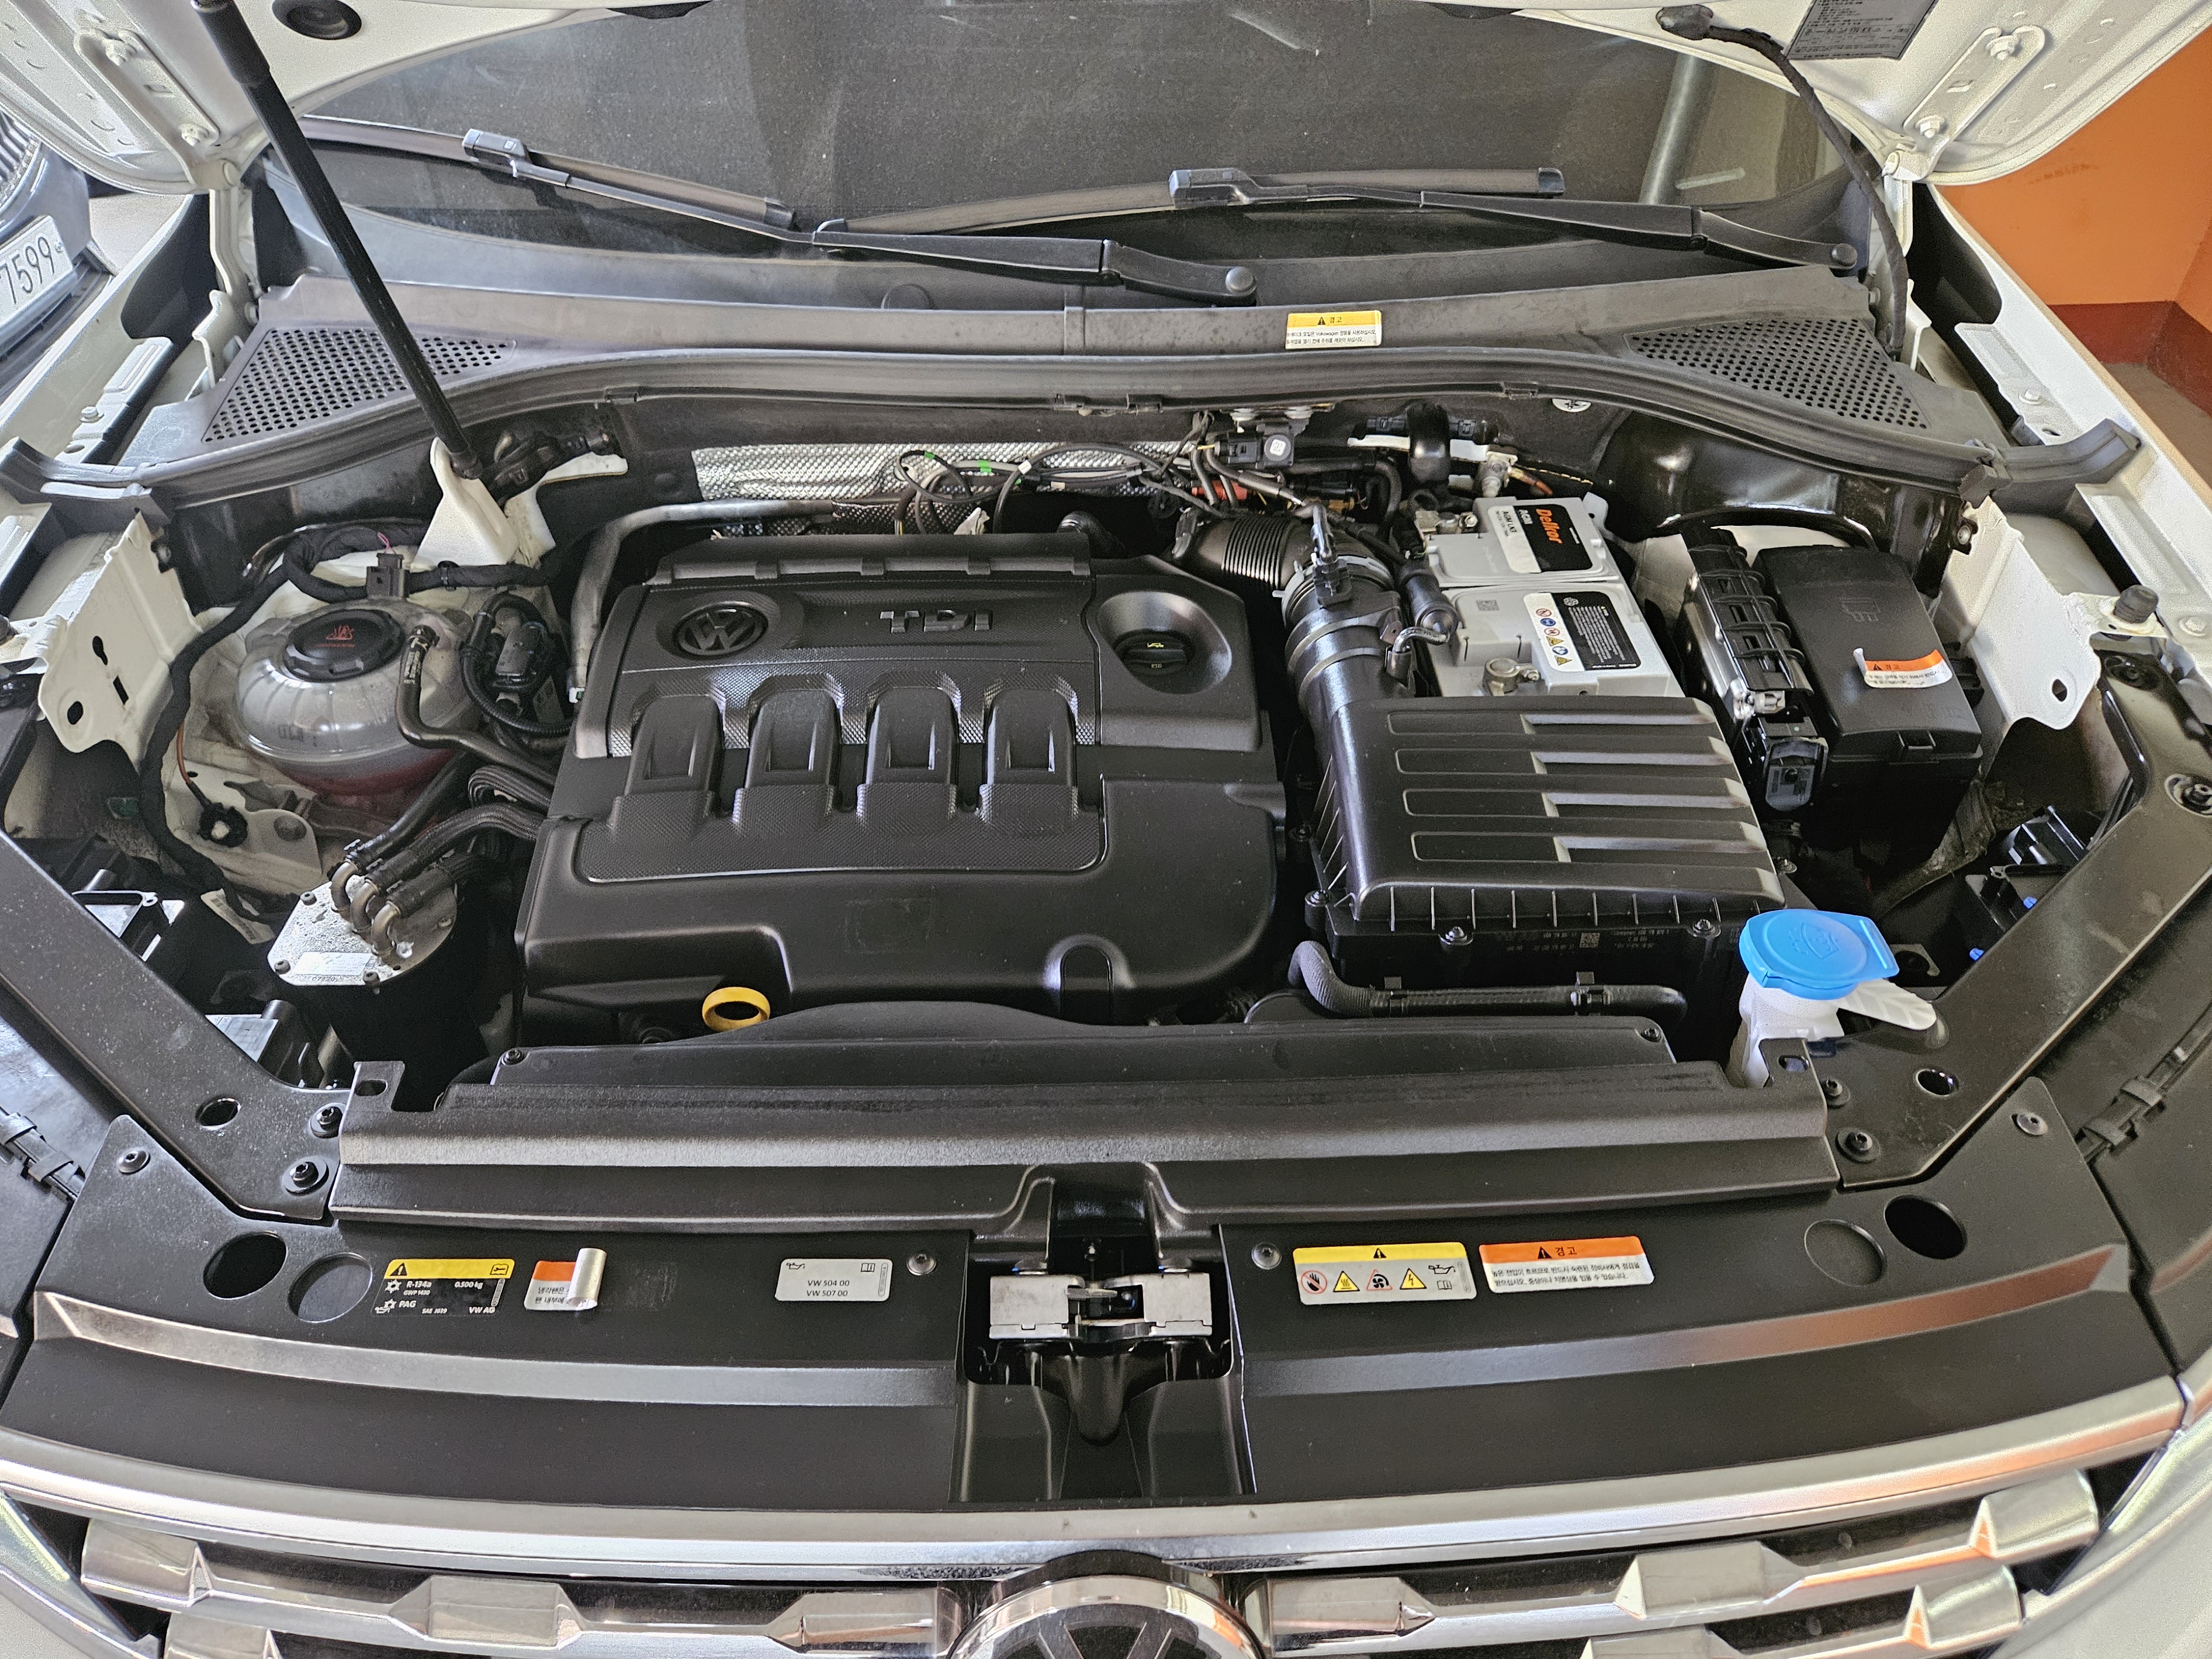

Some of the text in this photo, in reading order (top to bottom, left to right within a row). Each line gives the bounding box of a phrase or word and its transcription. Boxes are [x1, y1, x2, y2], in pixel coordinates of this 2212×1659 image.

[0, 236, 55, 305] 7599
[1502, 511, 1512, 525] AGM
[1536, 508, 1563, 544] Delkor
[880, 609, 990, 633] TDI
[1556, 1246, 1578, 1256] 경고
[538, 1286, 565, 1295] 냉각팬은
